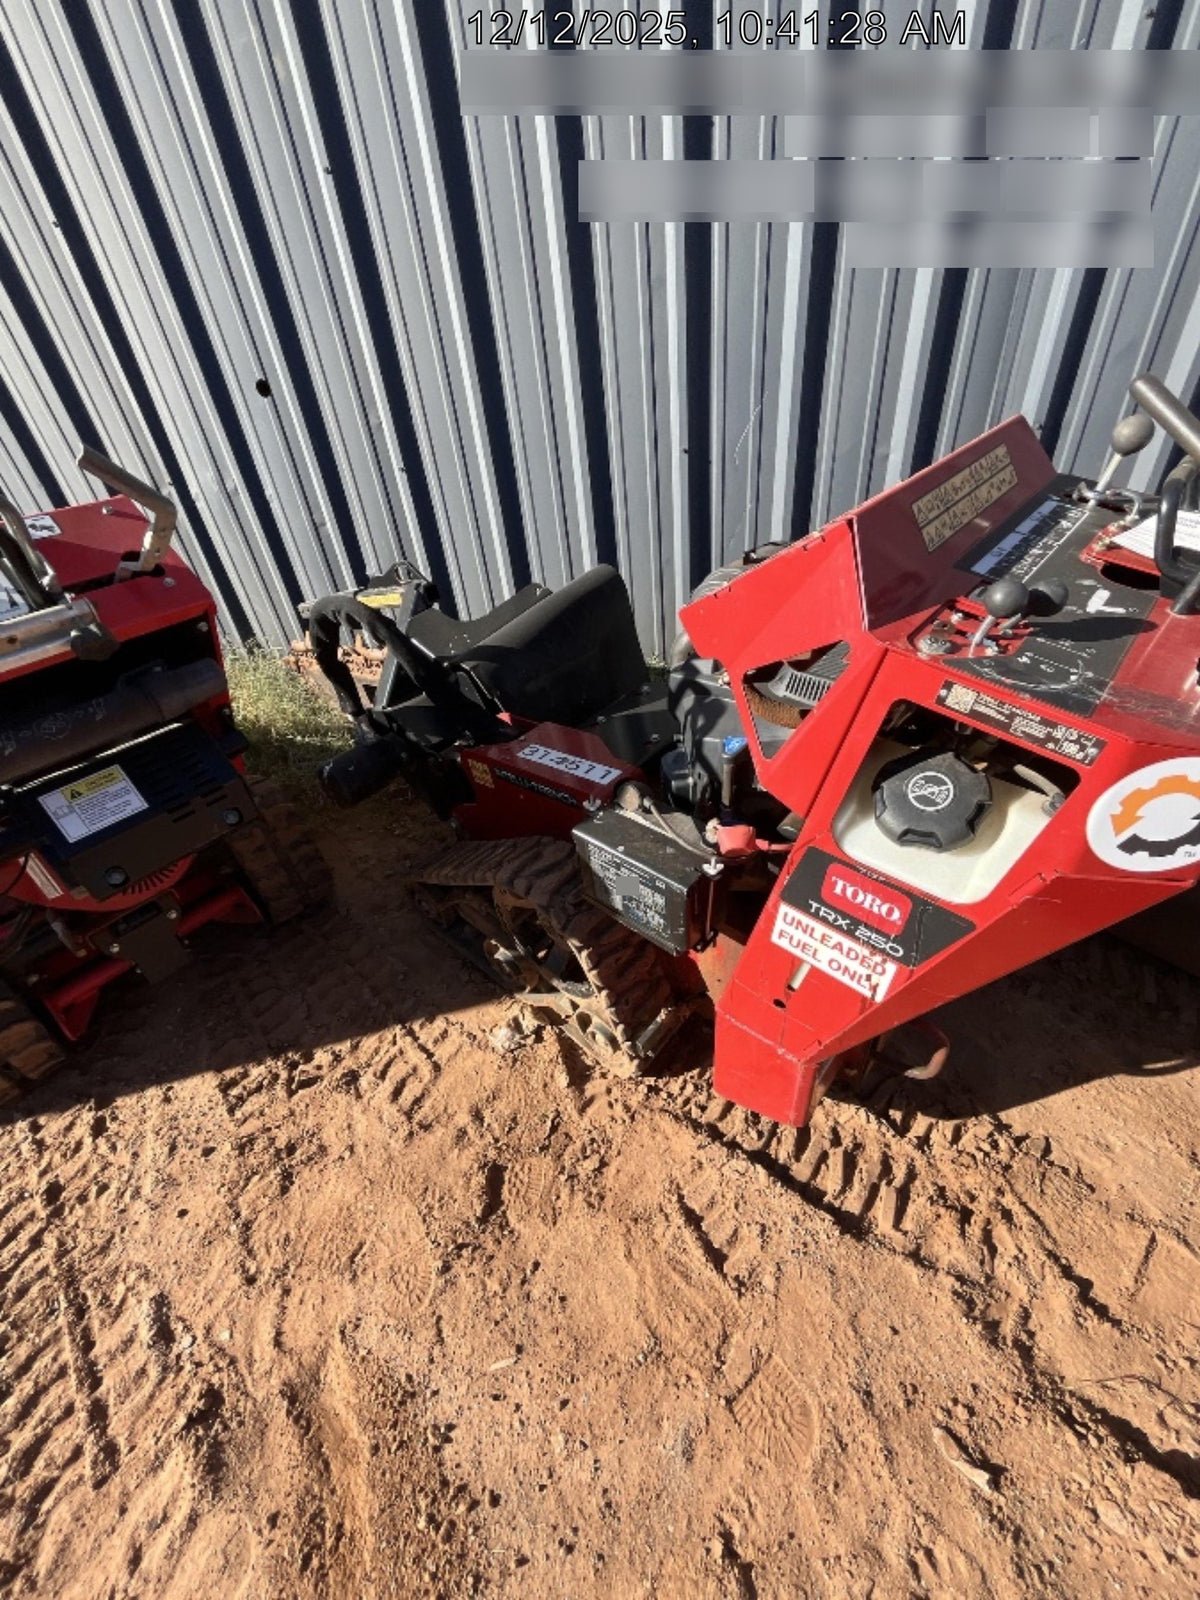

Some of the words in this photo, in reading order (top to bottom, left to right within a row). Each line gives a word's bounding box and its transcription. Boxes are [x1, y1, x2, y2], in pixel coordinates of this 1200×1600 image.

[831, 875, 901, 922] TORO
[778, 929, 820, 963] FUEL
[783, 911, 886, 976] UNLEADED
